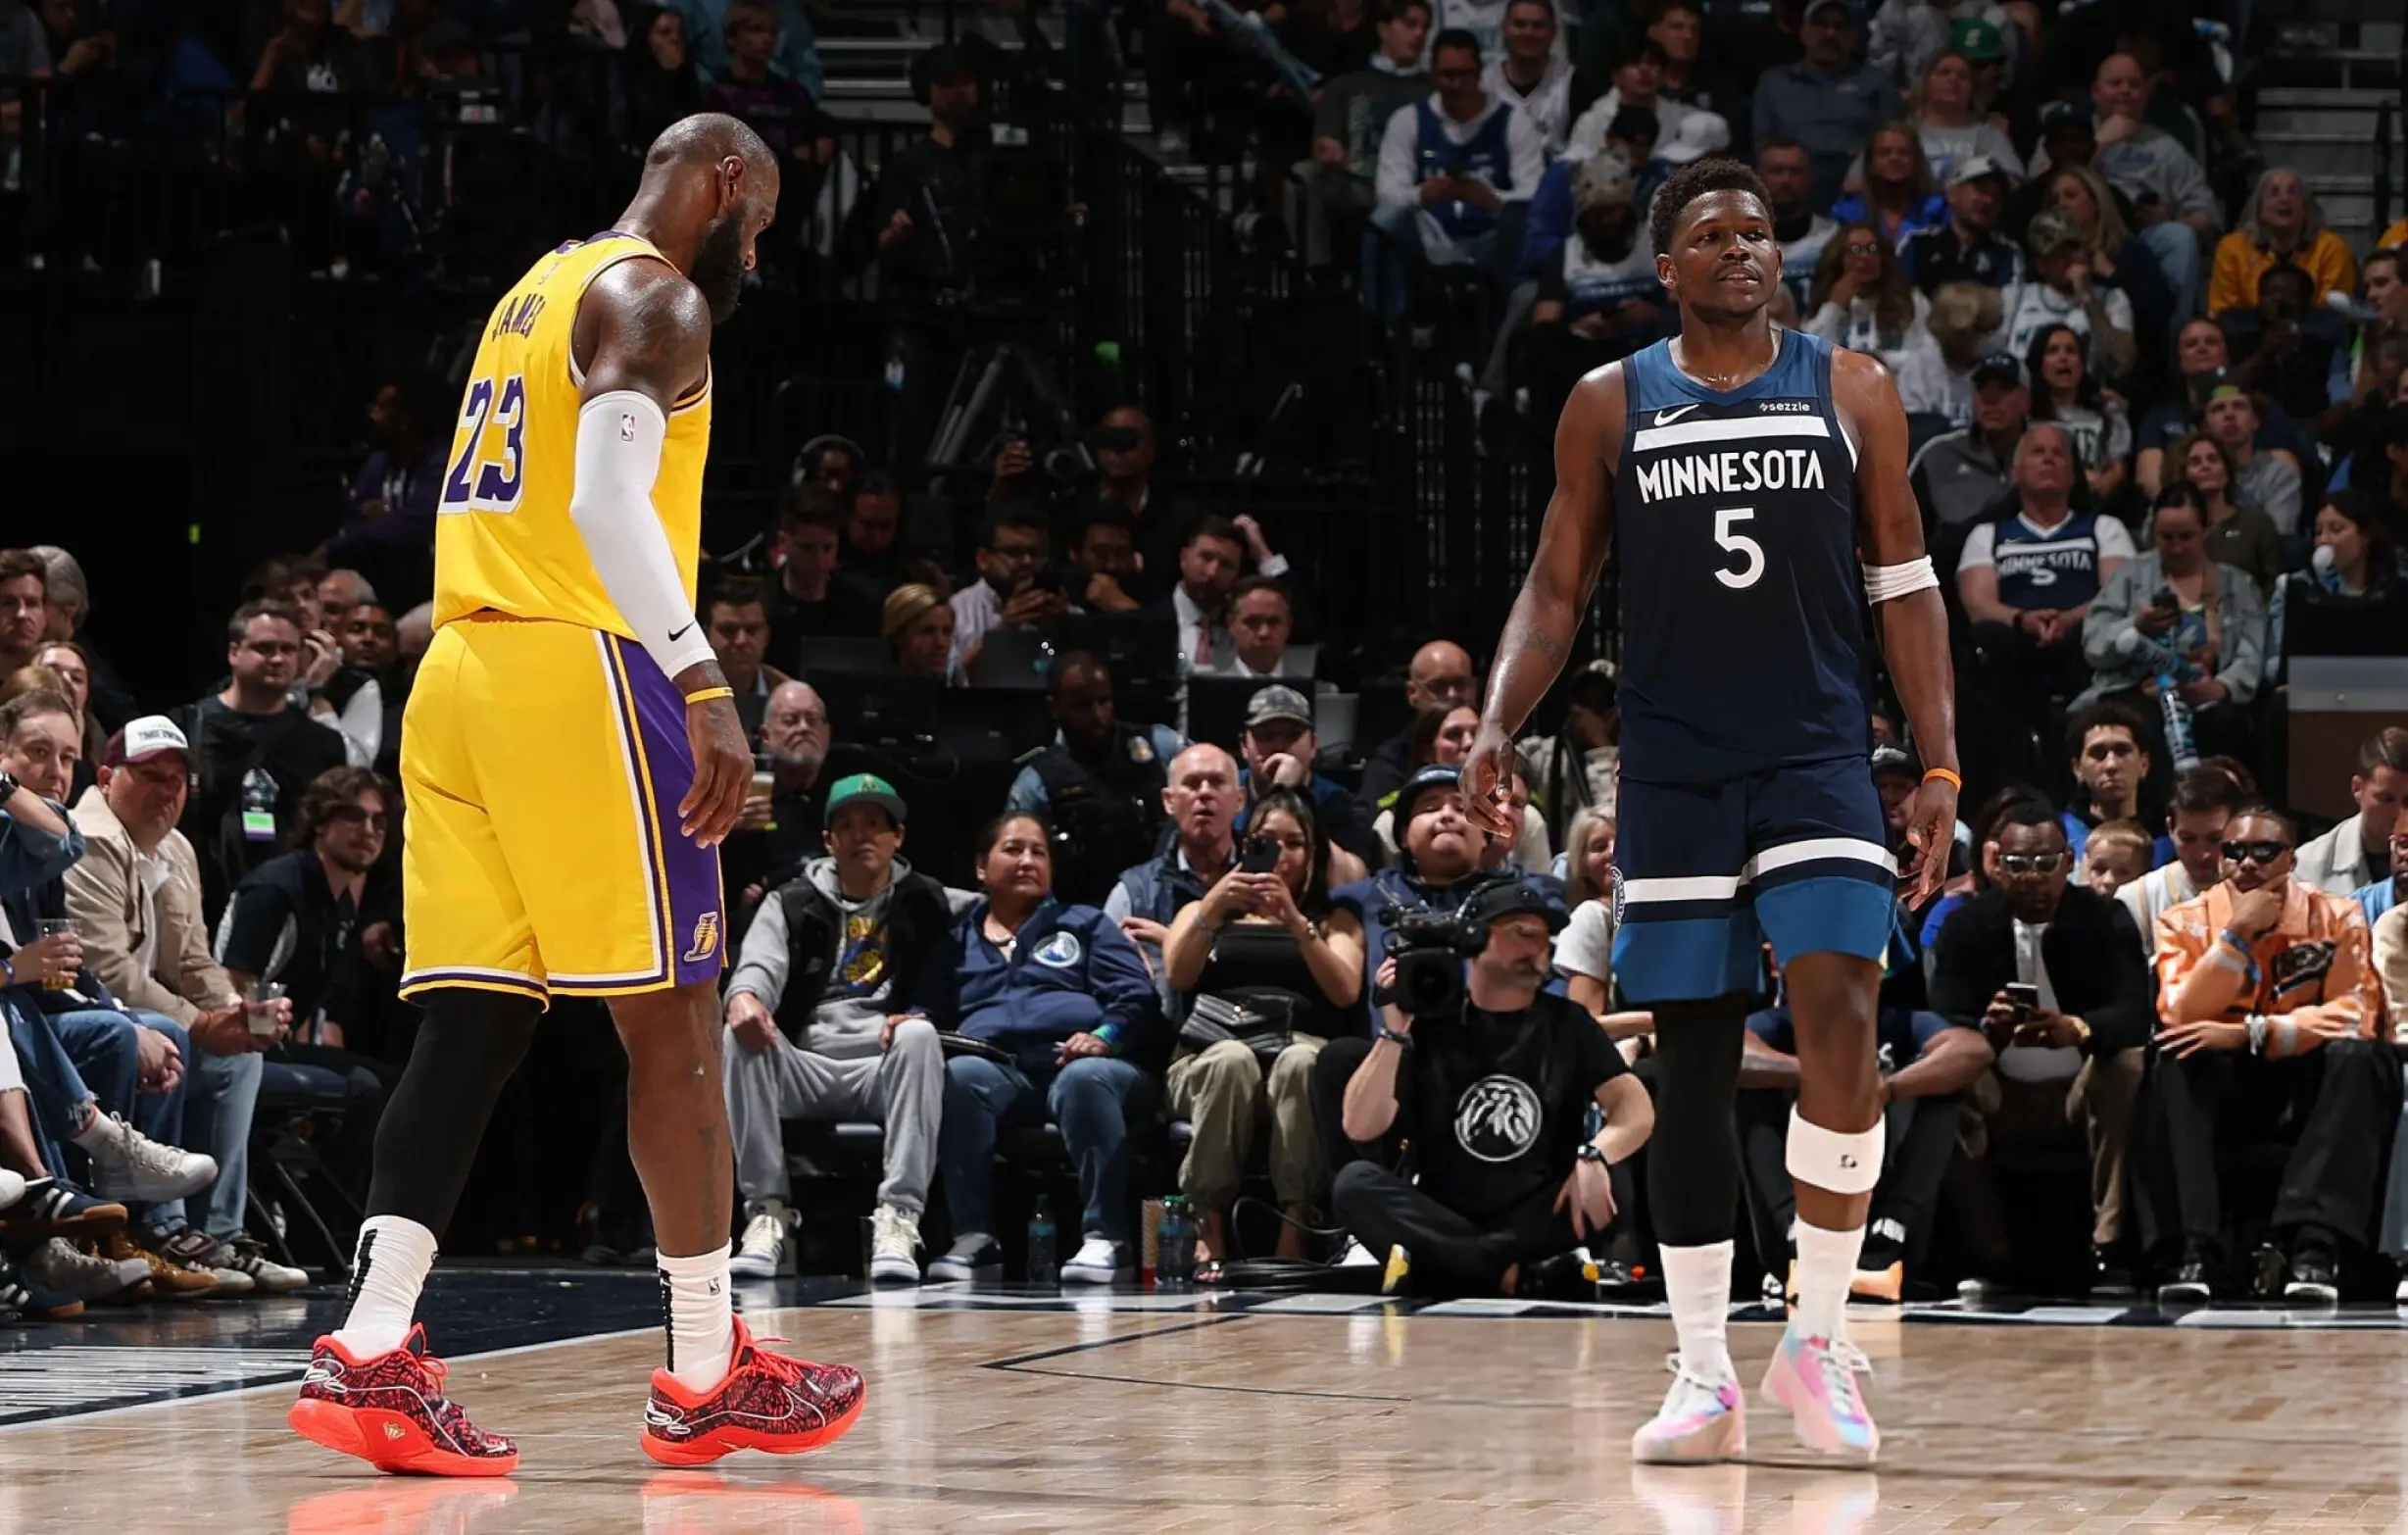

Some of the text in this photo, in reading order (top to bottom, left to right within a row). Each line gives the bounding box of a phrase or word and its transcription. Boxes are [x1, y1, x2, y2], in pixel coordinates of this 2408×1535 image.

[1768, 401, 1810, 413] sezzle
[437, 374, 525, 515] 23
[1637, 449, 1825, 504] MINNESOTA
[1714, 507, 1765, 589] 5
